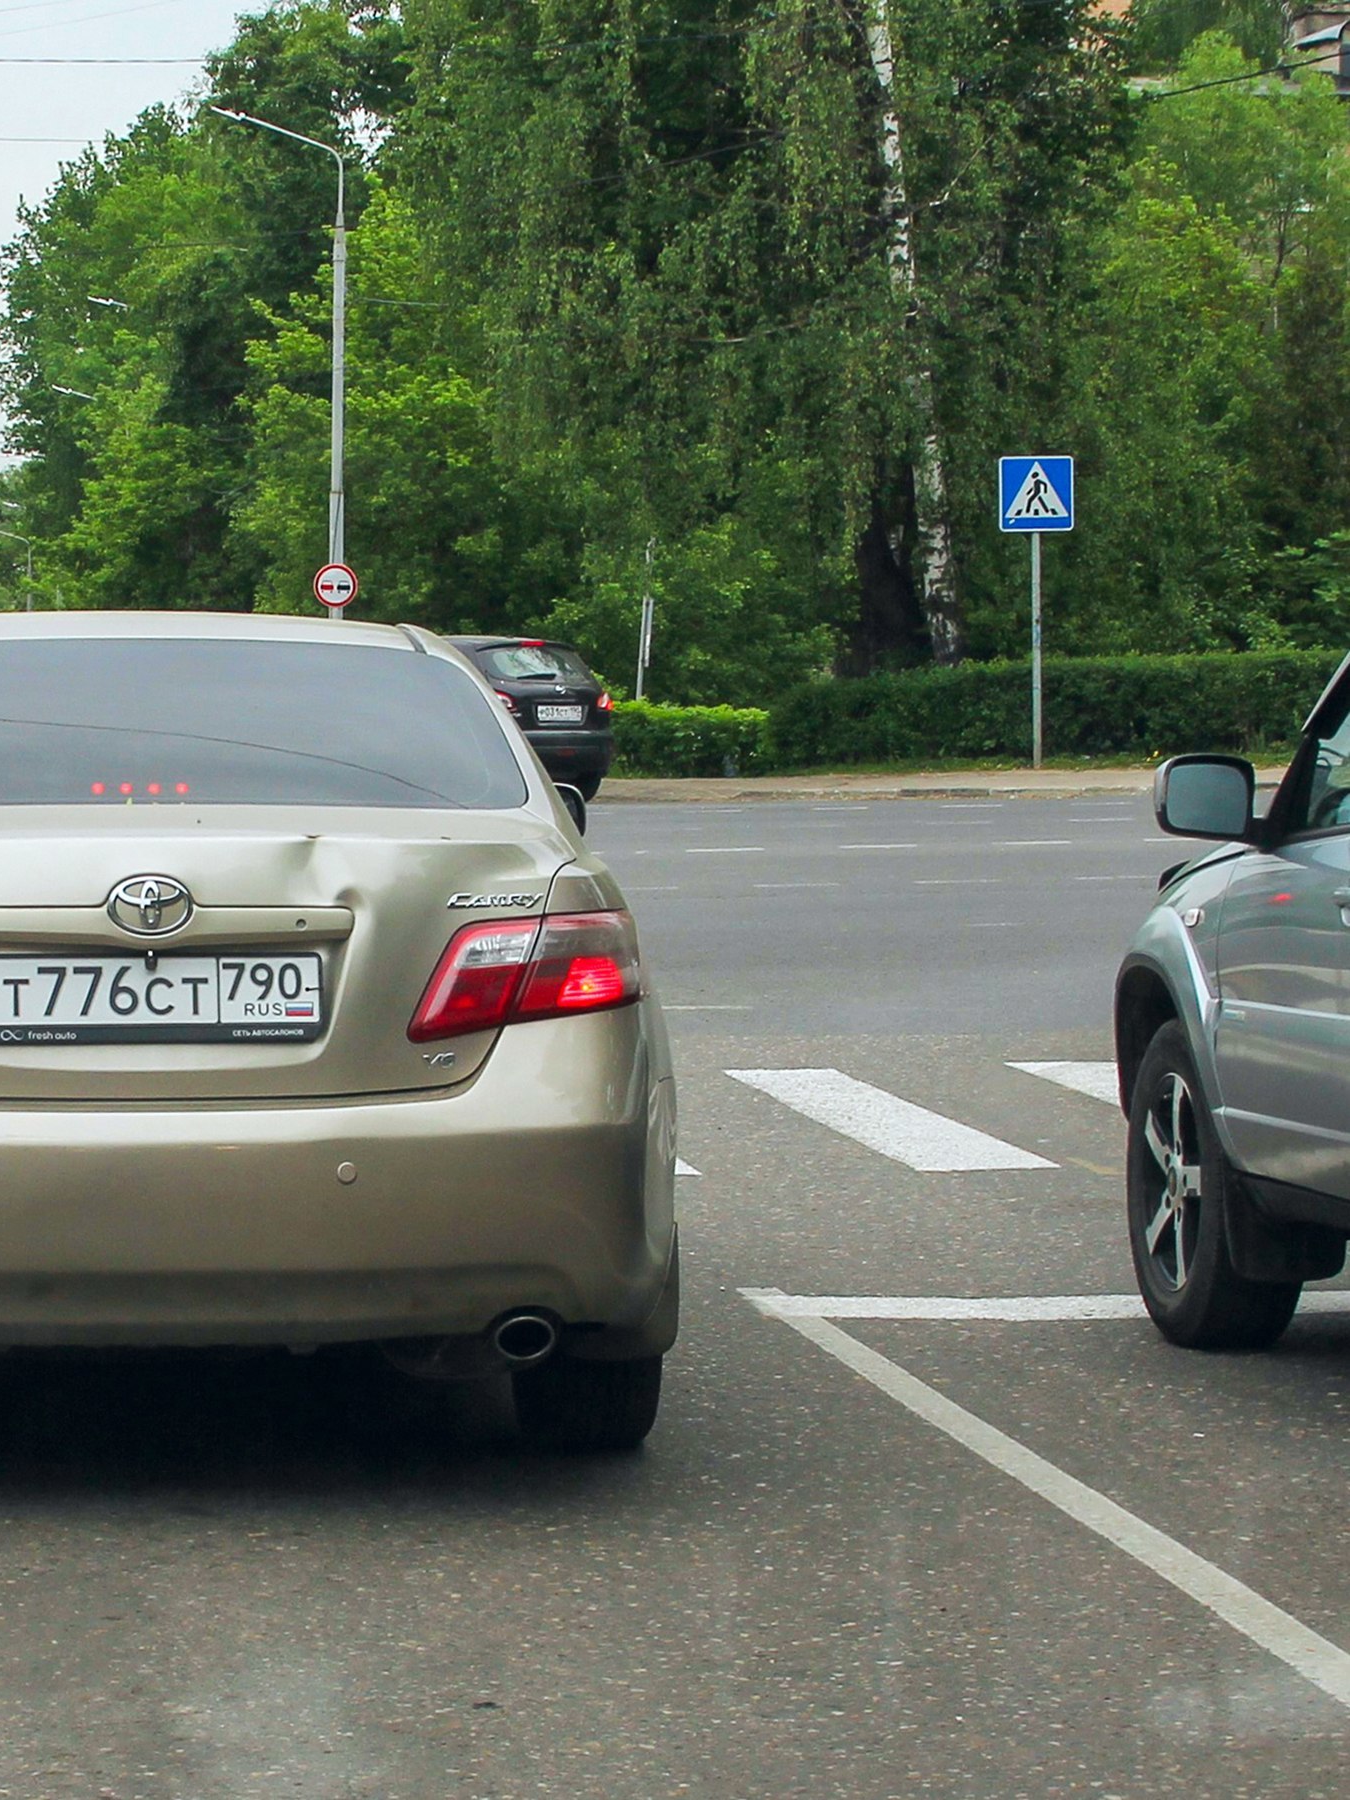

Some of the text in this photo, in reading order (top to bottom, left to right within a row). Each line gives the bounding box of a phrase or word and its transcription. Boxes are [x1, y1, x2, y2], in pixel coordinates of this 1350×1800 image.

[244, 1003, 282, 1016] RUS
[28, 1031, 77, 1040] fresh auto
[232, 1029, 304, 1037] СЕТЬ АВТОСАЛОНОВ
[422, 1052, 455, 1069] V6
